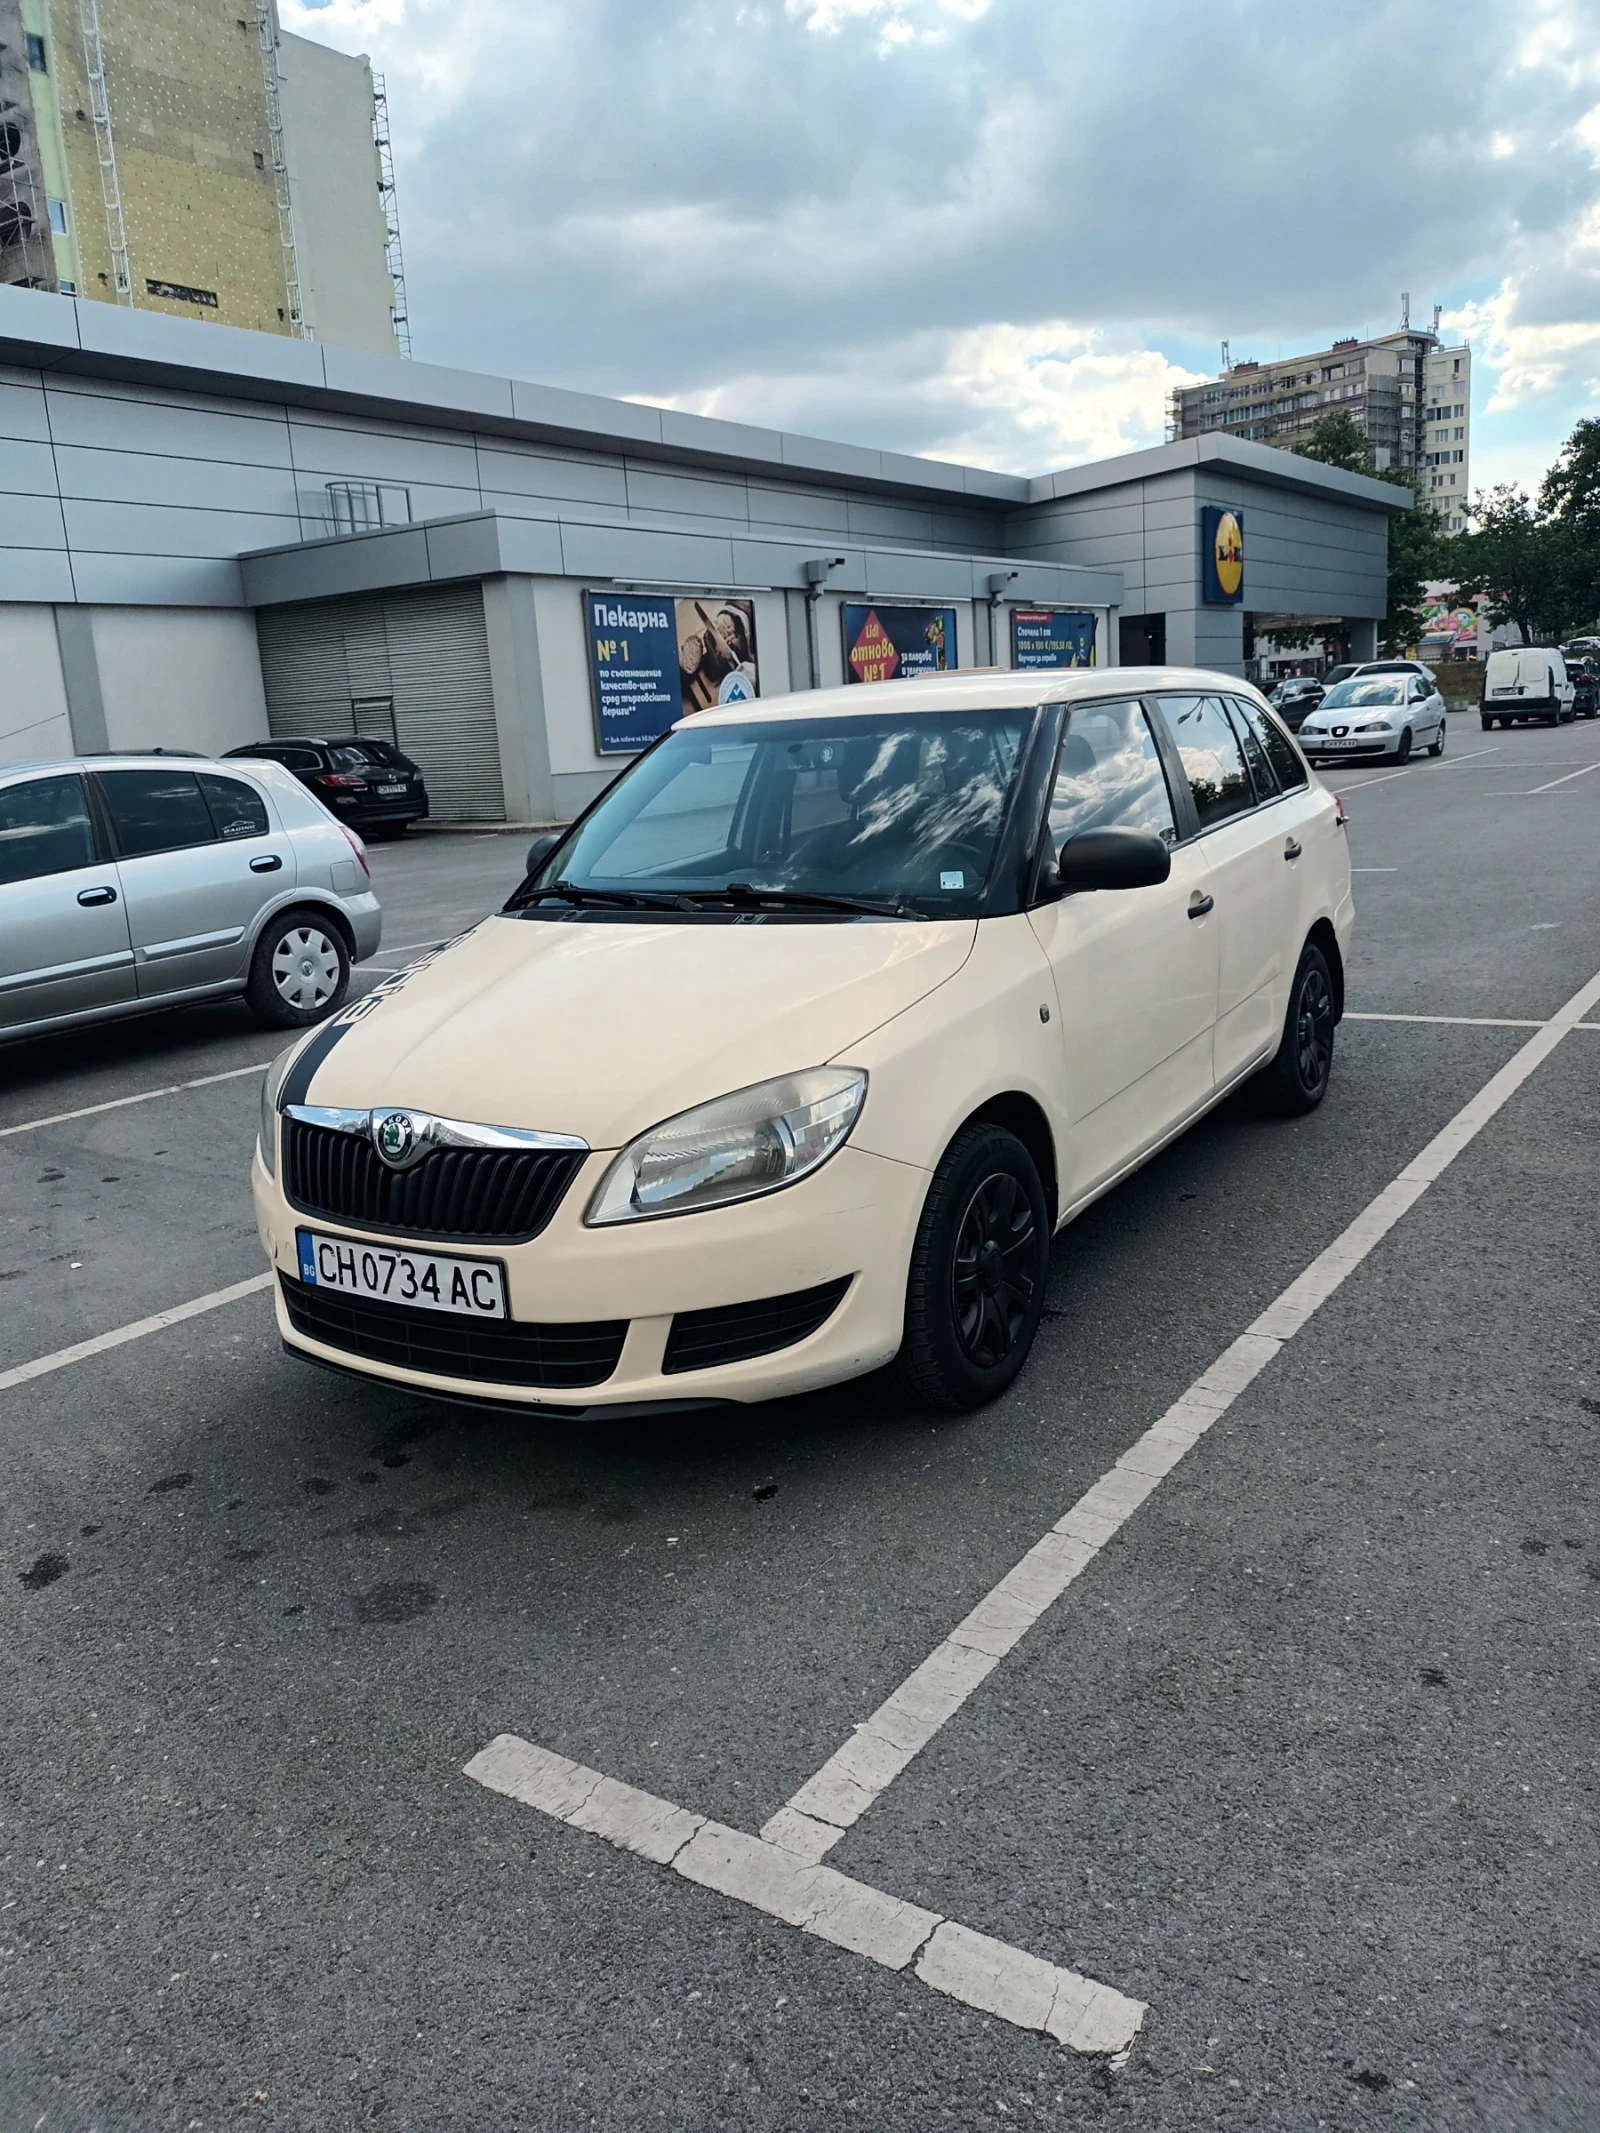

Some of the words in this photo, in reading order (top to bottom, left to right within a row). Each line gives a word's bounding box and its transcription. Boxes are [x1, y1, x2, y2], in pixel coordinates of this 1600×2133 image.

[594, 604, 669, 633] Пекарна
[865, 623, 879, 638] Lidl
[851, 637, 894, 662] отново
[901, 652, 908, 664] за
[908, 650, 932, 664] плодове
[599, 669, 610, 678] по
[610, 669, 662, 678] съотношение
[600, 680, 657, 691] качество-цена
[601, 694, 620, 705] сред
[621, 692, 671, 705] търговските
[303, 1263, 315, 1276] BG
